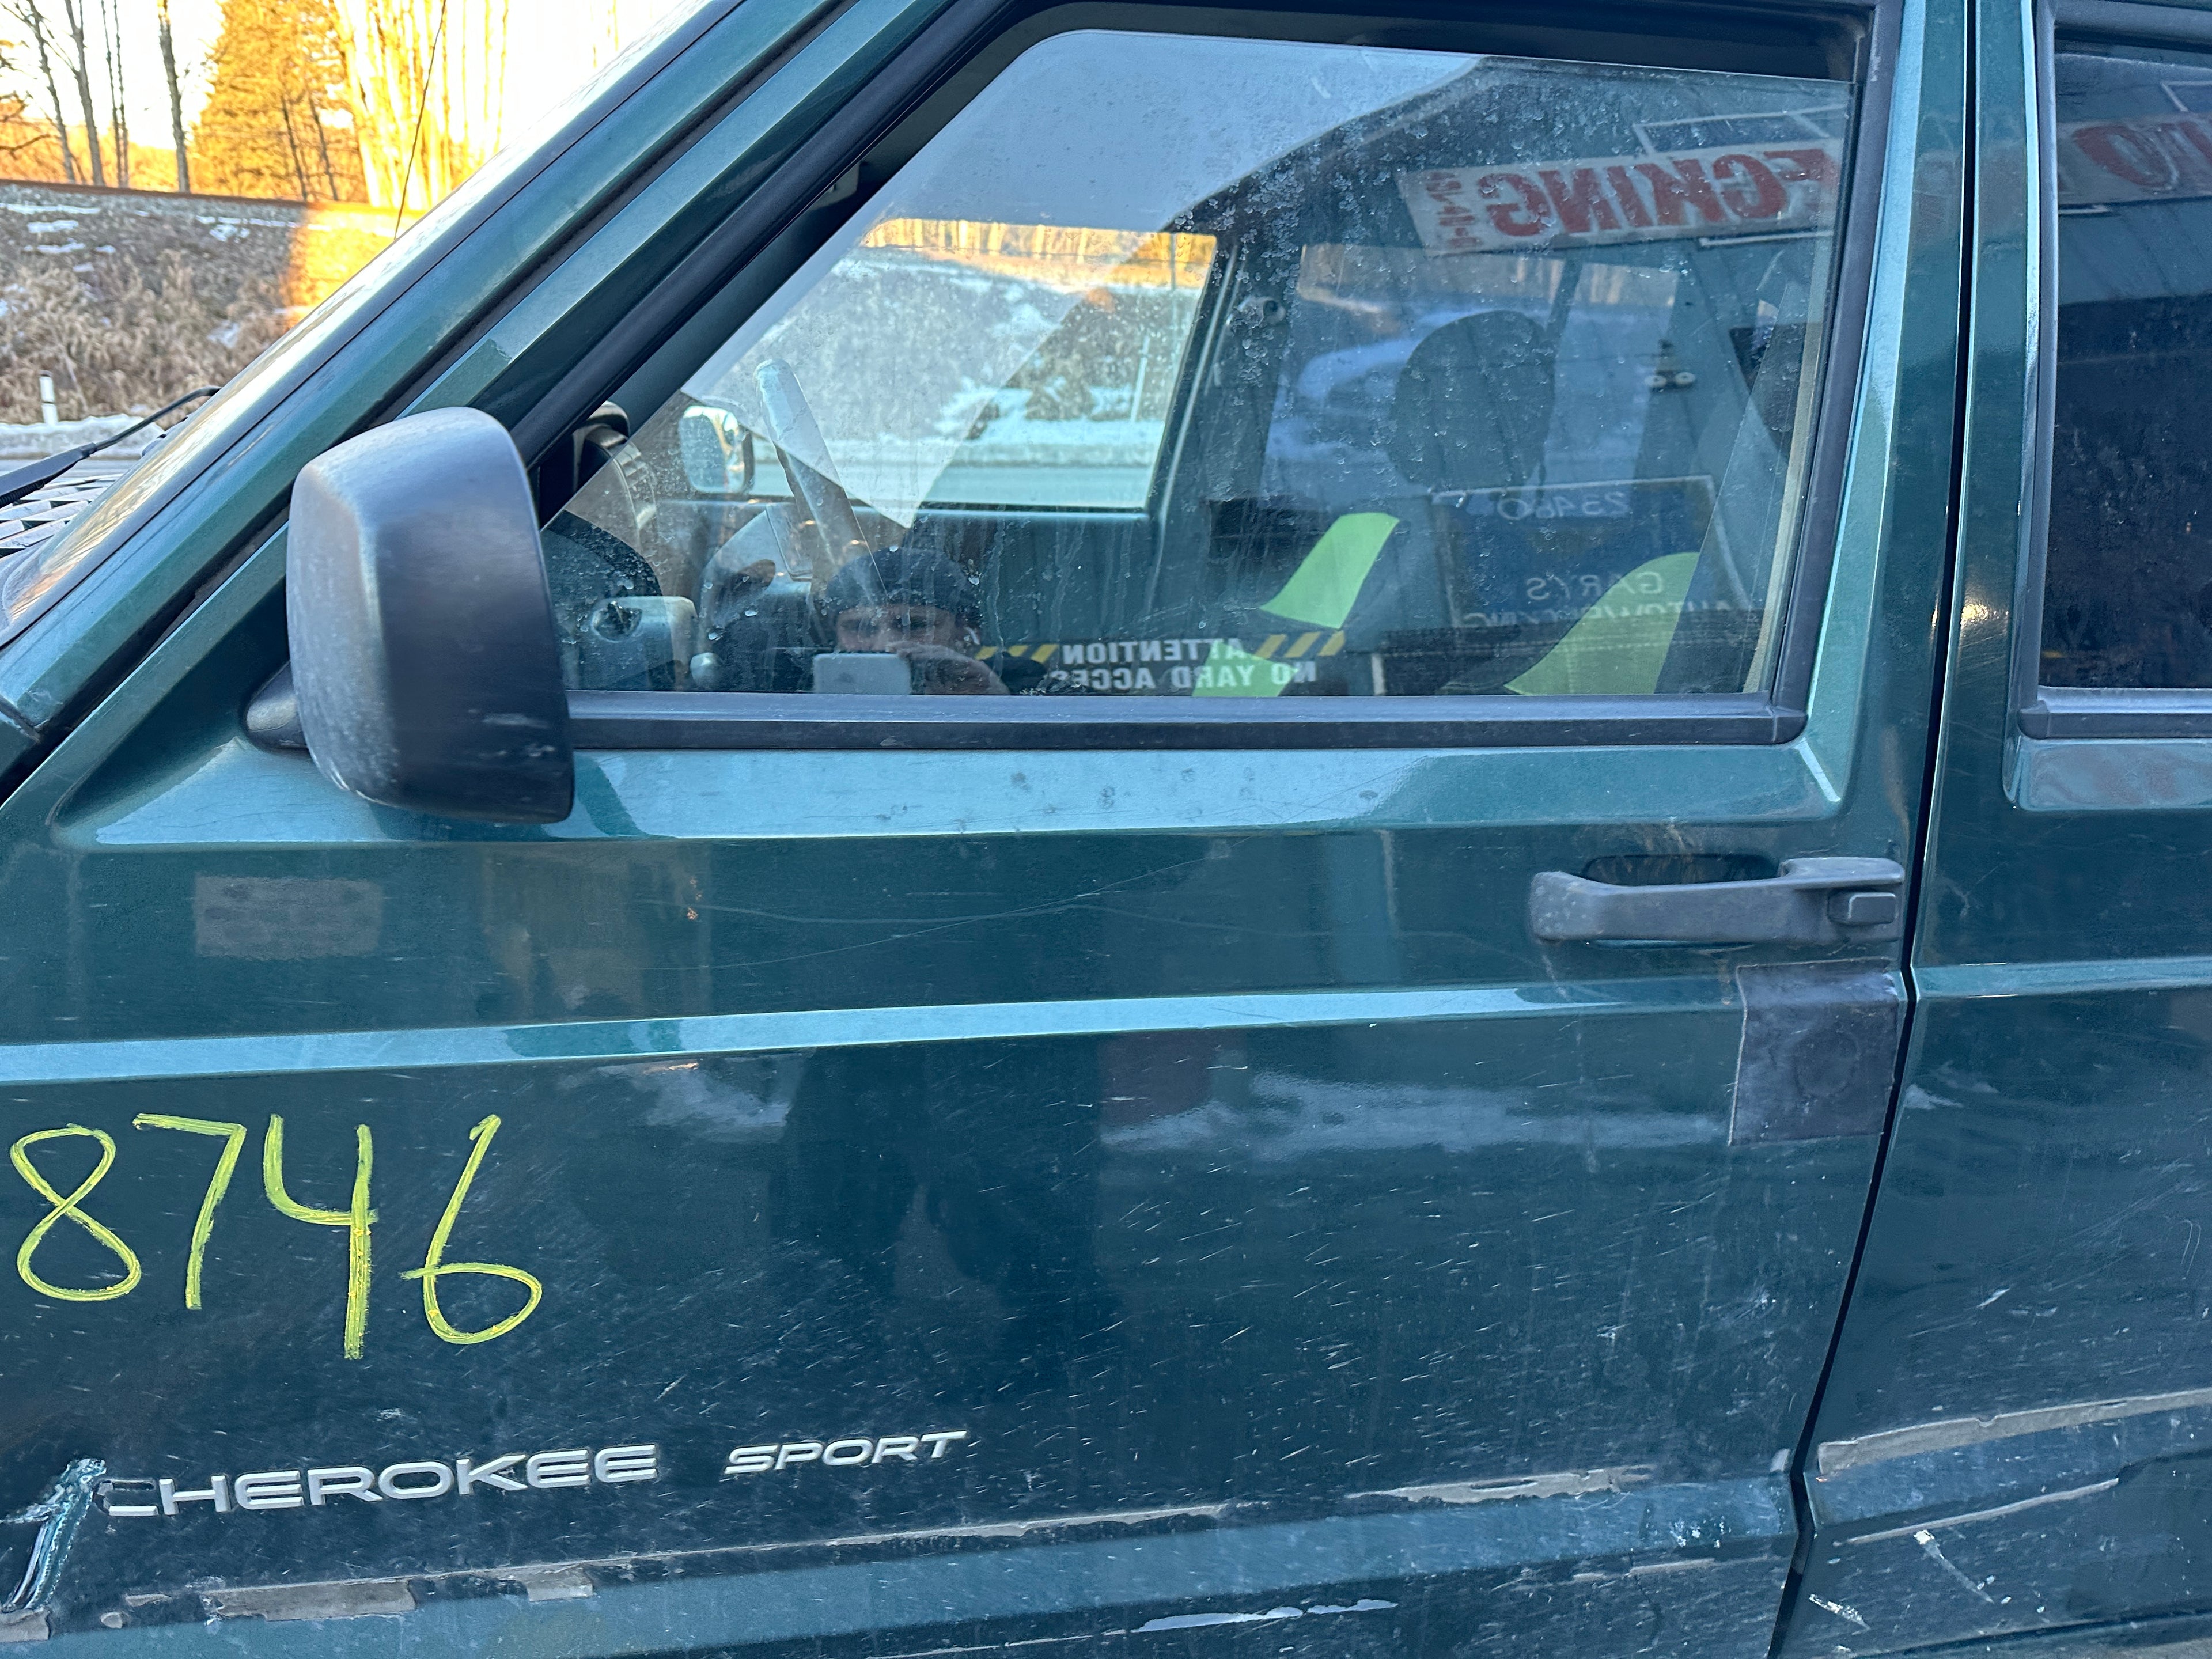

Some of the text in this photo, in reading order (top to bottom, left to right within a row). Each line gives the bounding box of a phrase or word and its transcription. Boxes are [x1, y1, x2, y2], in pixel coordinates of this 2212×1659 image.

[10, 1113, 543, 1361] 8746
[93, 1430, 969, 1517] CHEROKEE SPORT
